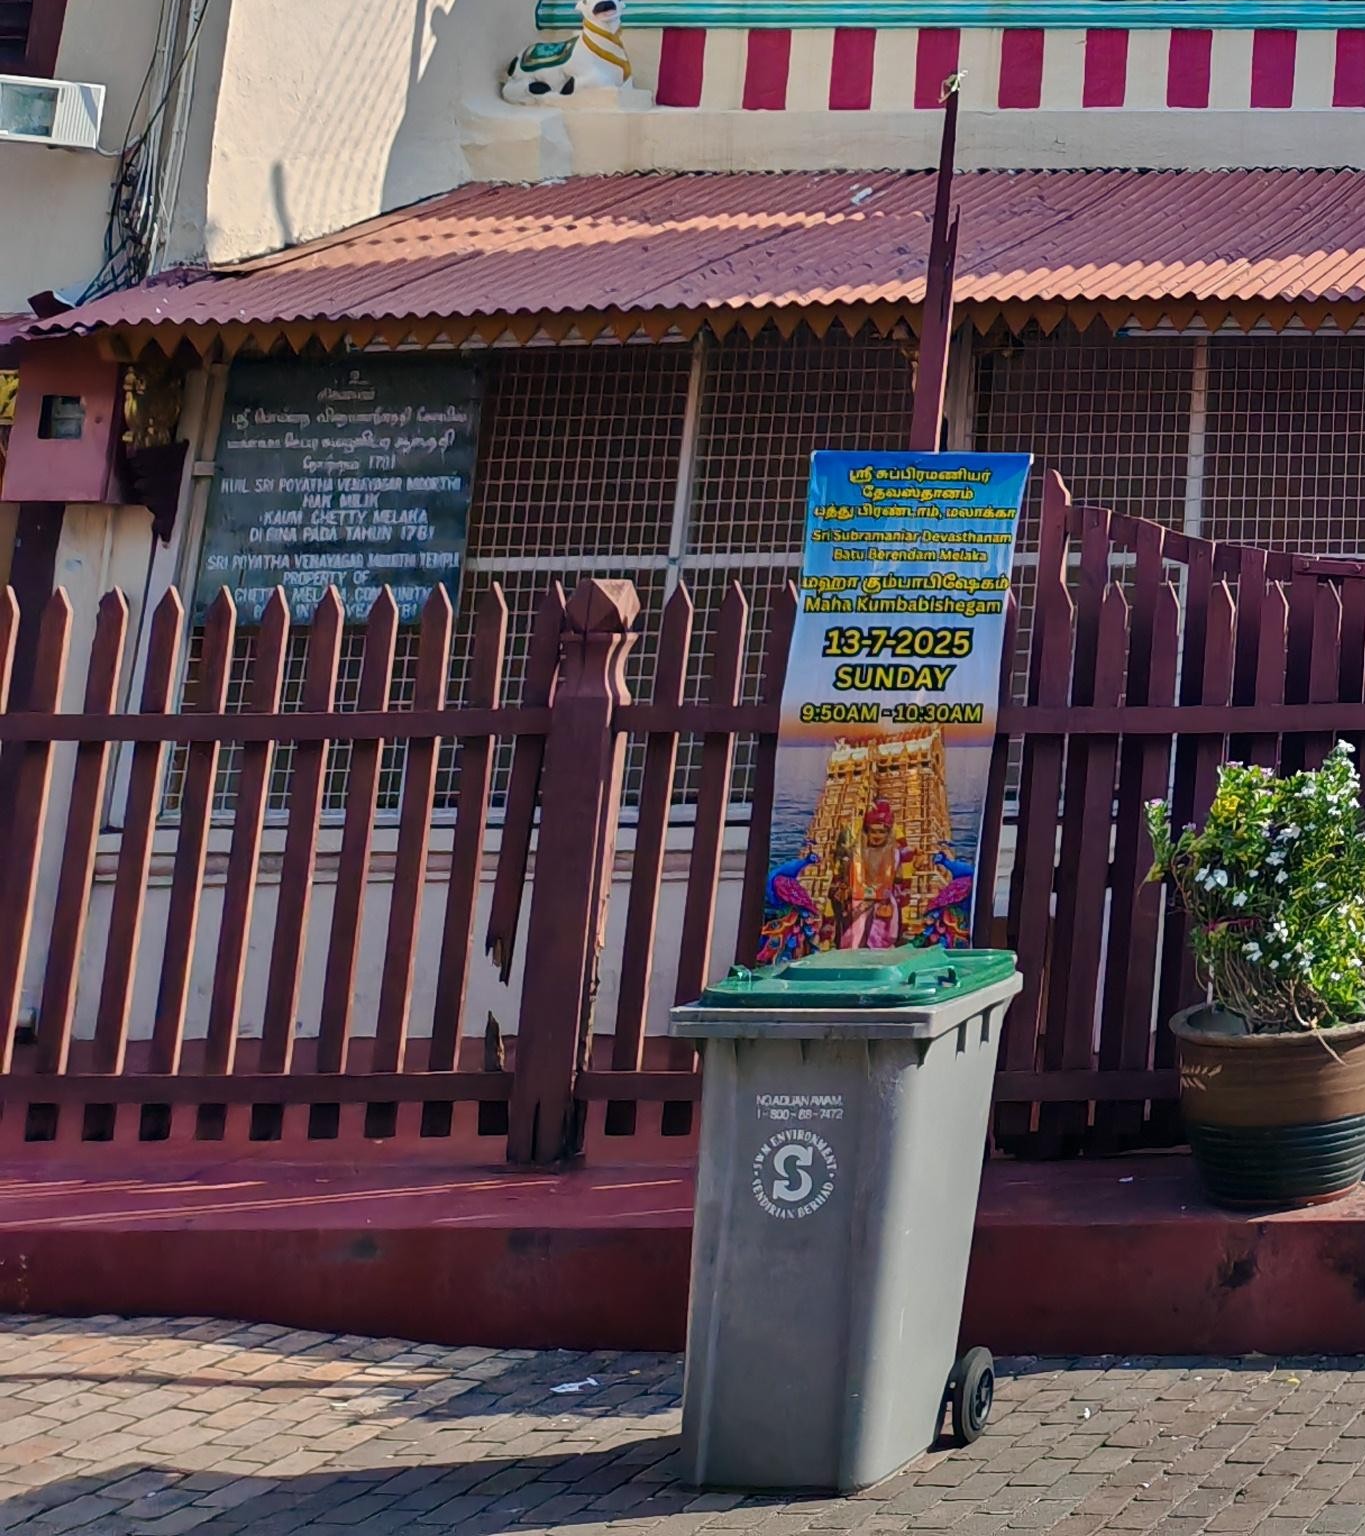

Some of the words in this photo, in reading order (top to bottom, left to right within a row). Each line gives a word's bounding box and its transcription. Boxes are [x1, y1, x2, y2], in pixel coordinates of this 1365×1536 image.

[254, 478, 274, 493] SRI
[311, 509, 366, 525] CHETTY
[372, 508, 429, 524] MELAKA
[302, 526, 339, 542] PADA
[346, 526, 393, 542] TAHUN
[400, 525, 435, 542] 1781
[812, 529, 831, 543] Sri
[833, 529, 920, 543] Subramaniar
[922, 529, 1013, 544] Devasthanam
[207, 554, 228, 570] SRI
[868, 547, 937, 562] Berendam
[283, 571, 347, 586] PROPERTY
[353, 570, 371, 585] OF
[804, 595, 852, 613] Maha
[856, 595, 1002, 617] Kumbabishegam
[823, 627, 974, 658] 13-7-2025
[834, 665, 955, 691] SUNDAY
[801, 702, 880, 724] 9:50AM
[892, 702, 984, 724] 10:30AM
[769, 1129, 838, 1170] ENVIRONMENT
[751, 1178, 795, 1221] SENDIRIAN
[797, 1182, 834, 1219] BERHAD
